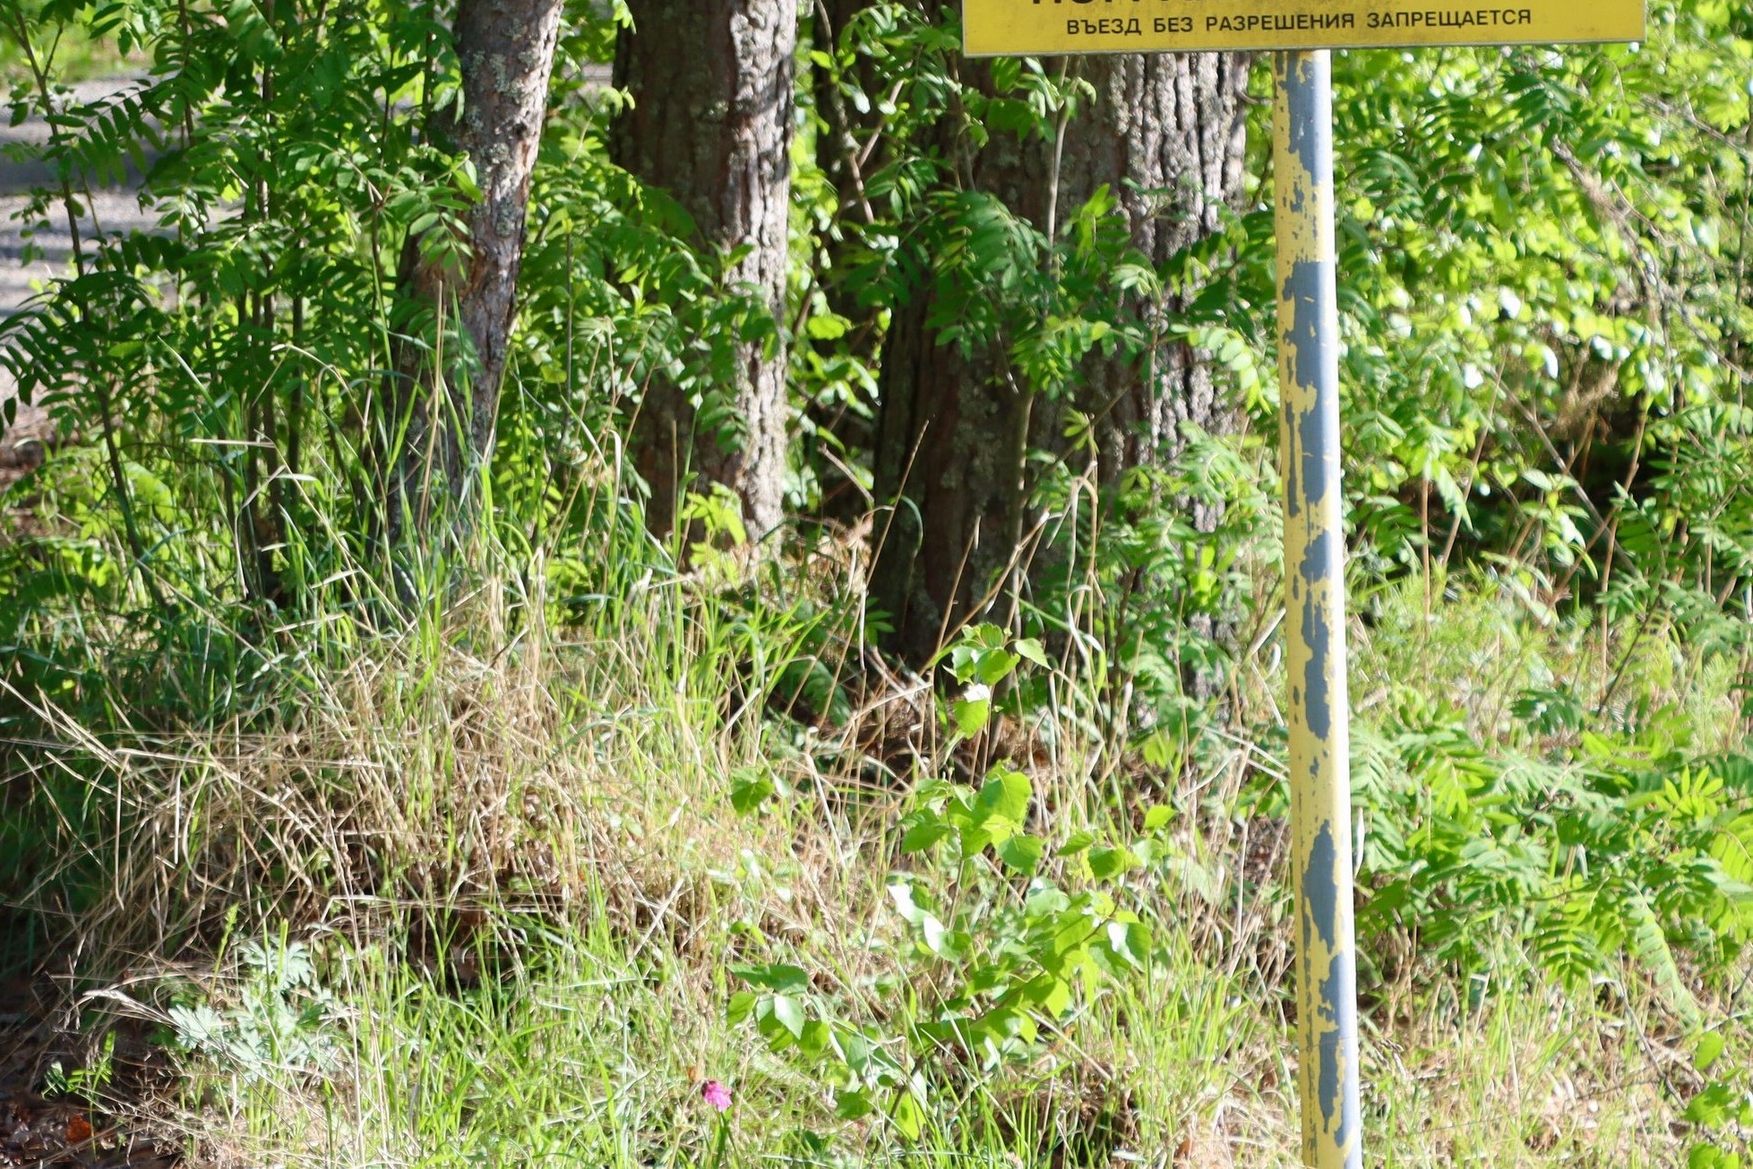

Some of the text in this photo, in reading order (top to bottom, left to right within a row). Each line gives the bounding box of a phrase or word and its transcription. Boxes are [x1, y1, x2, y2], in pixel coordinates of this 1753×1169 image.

[1066, 9, 1531, 36] ВЪЕЗД БЕЗ РАЗРЕШЕНИЯ ЗАПРЕЩАЕТСЯ
